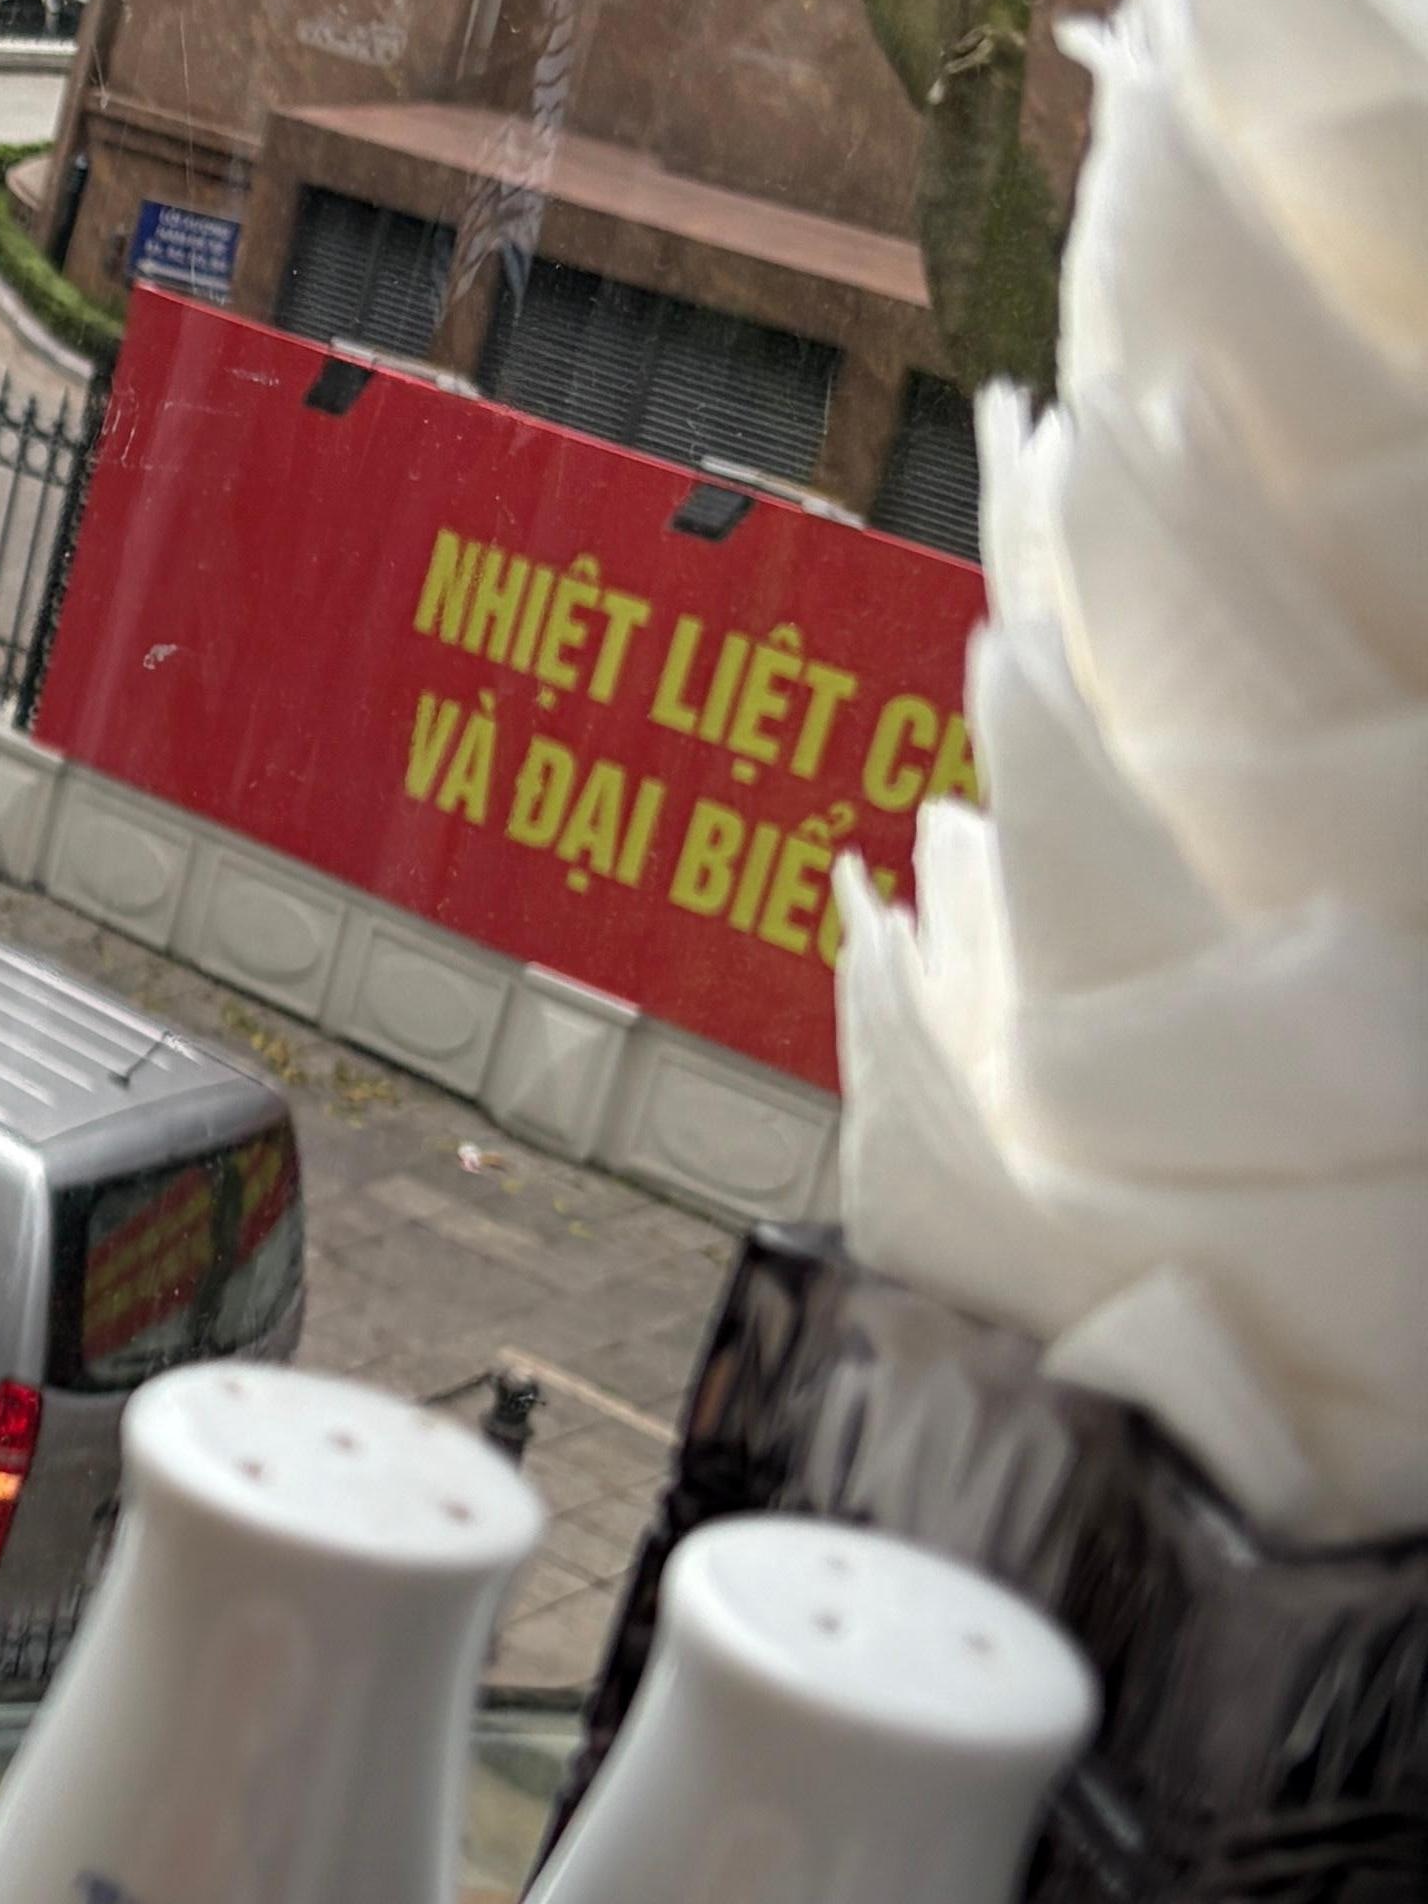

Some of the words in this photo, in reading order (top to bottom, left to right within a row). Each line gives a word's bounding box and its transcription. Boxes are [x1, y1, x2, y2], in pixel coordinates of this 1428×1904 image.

[413, 528, 652, 711] NHIỆT
[649, 612, 858, 785] LIỆT
[404, 689, 497, 826] VÀ
[505, 733, 667, 895] ĐẠI
